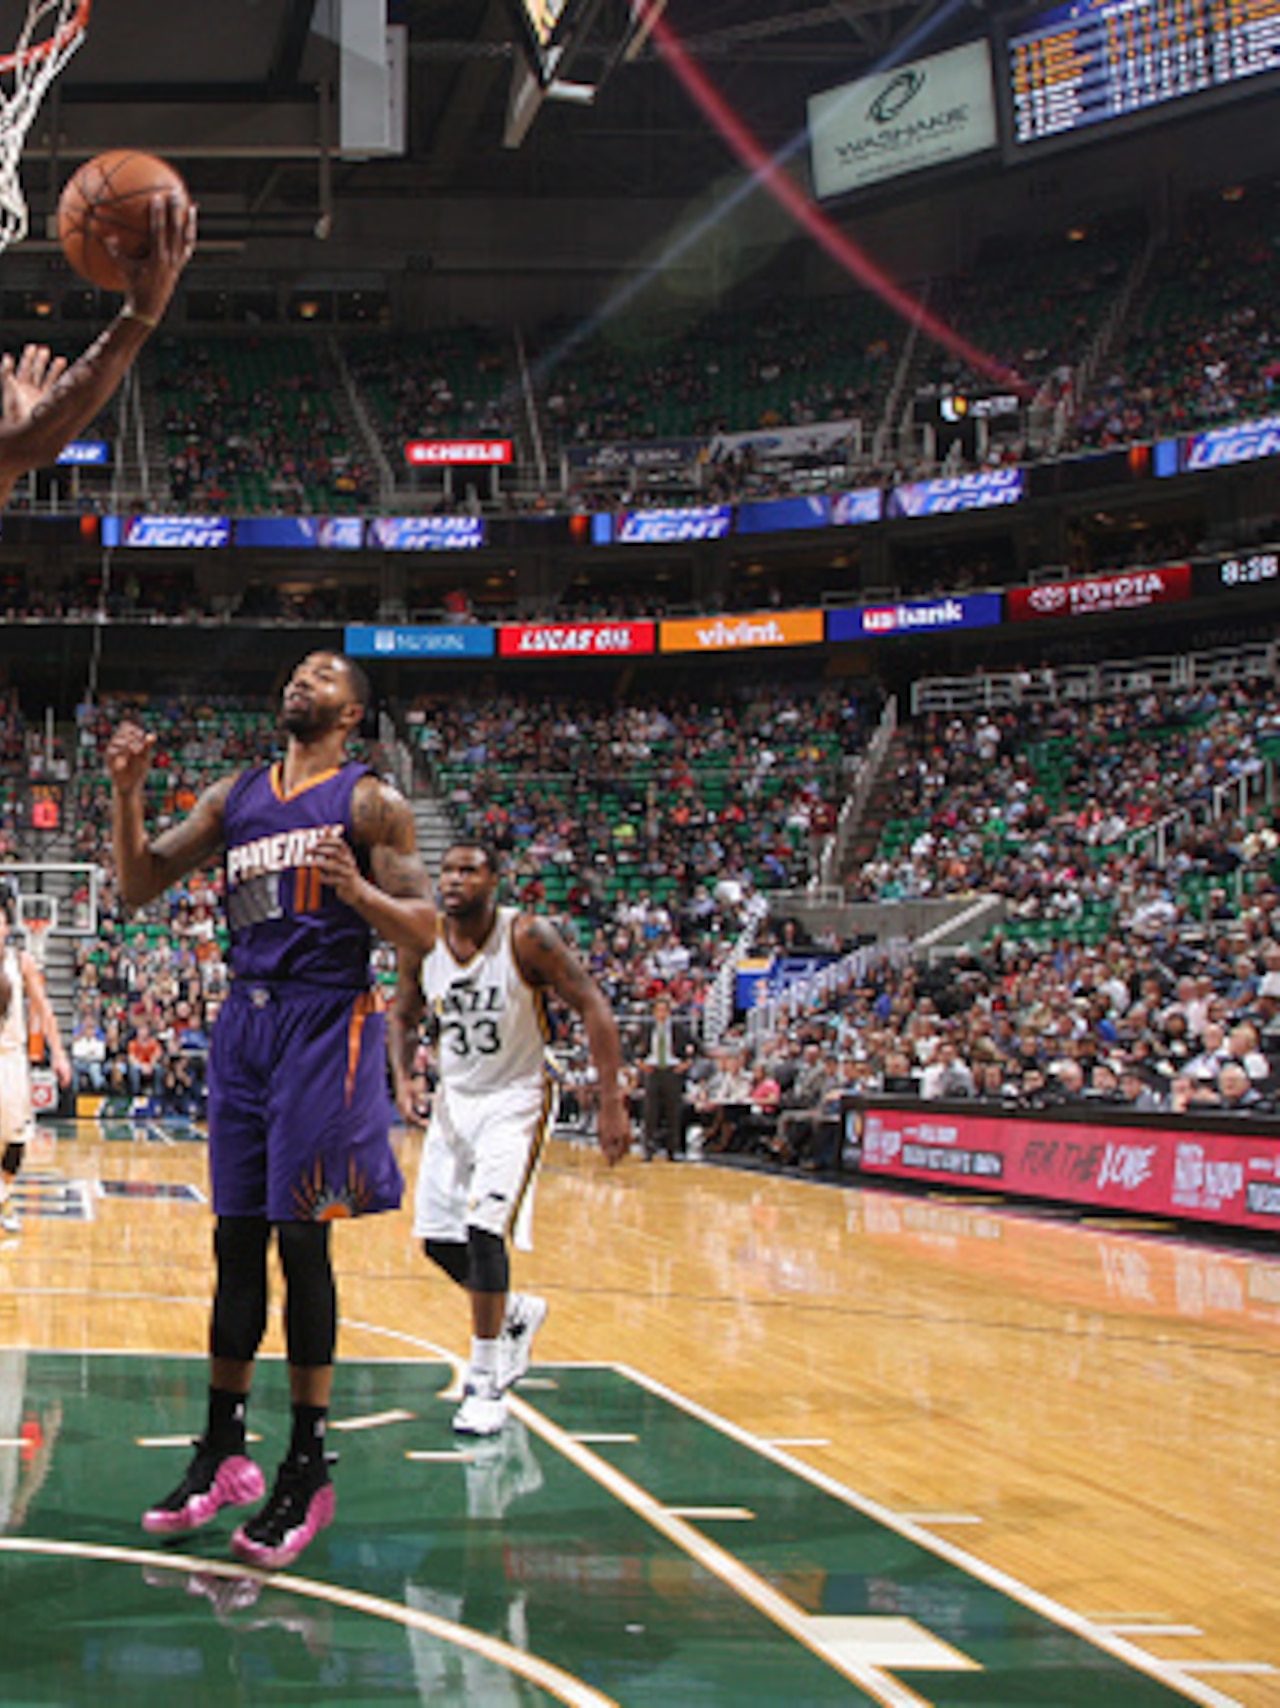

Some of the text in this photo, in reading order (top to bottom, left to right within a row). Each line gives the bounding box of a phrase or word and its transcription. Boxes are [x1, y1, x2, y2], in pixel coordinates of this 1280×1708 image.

[127, 522, 227, 547] LIGHT
[1070, 573, 1166, 603] TOYOTA
[518, 628, 592, 651] LUCAS
[442, 1019, 502, 1055] 33
